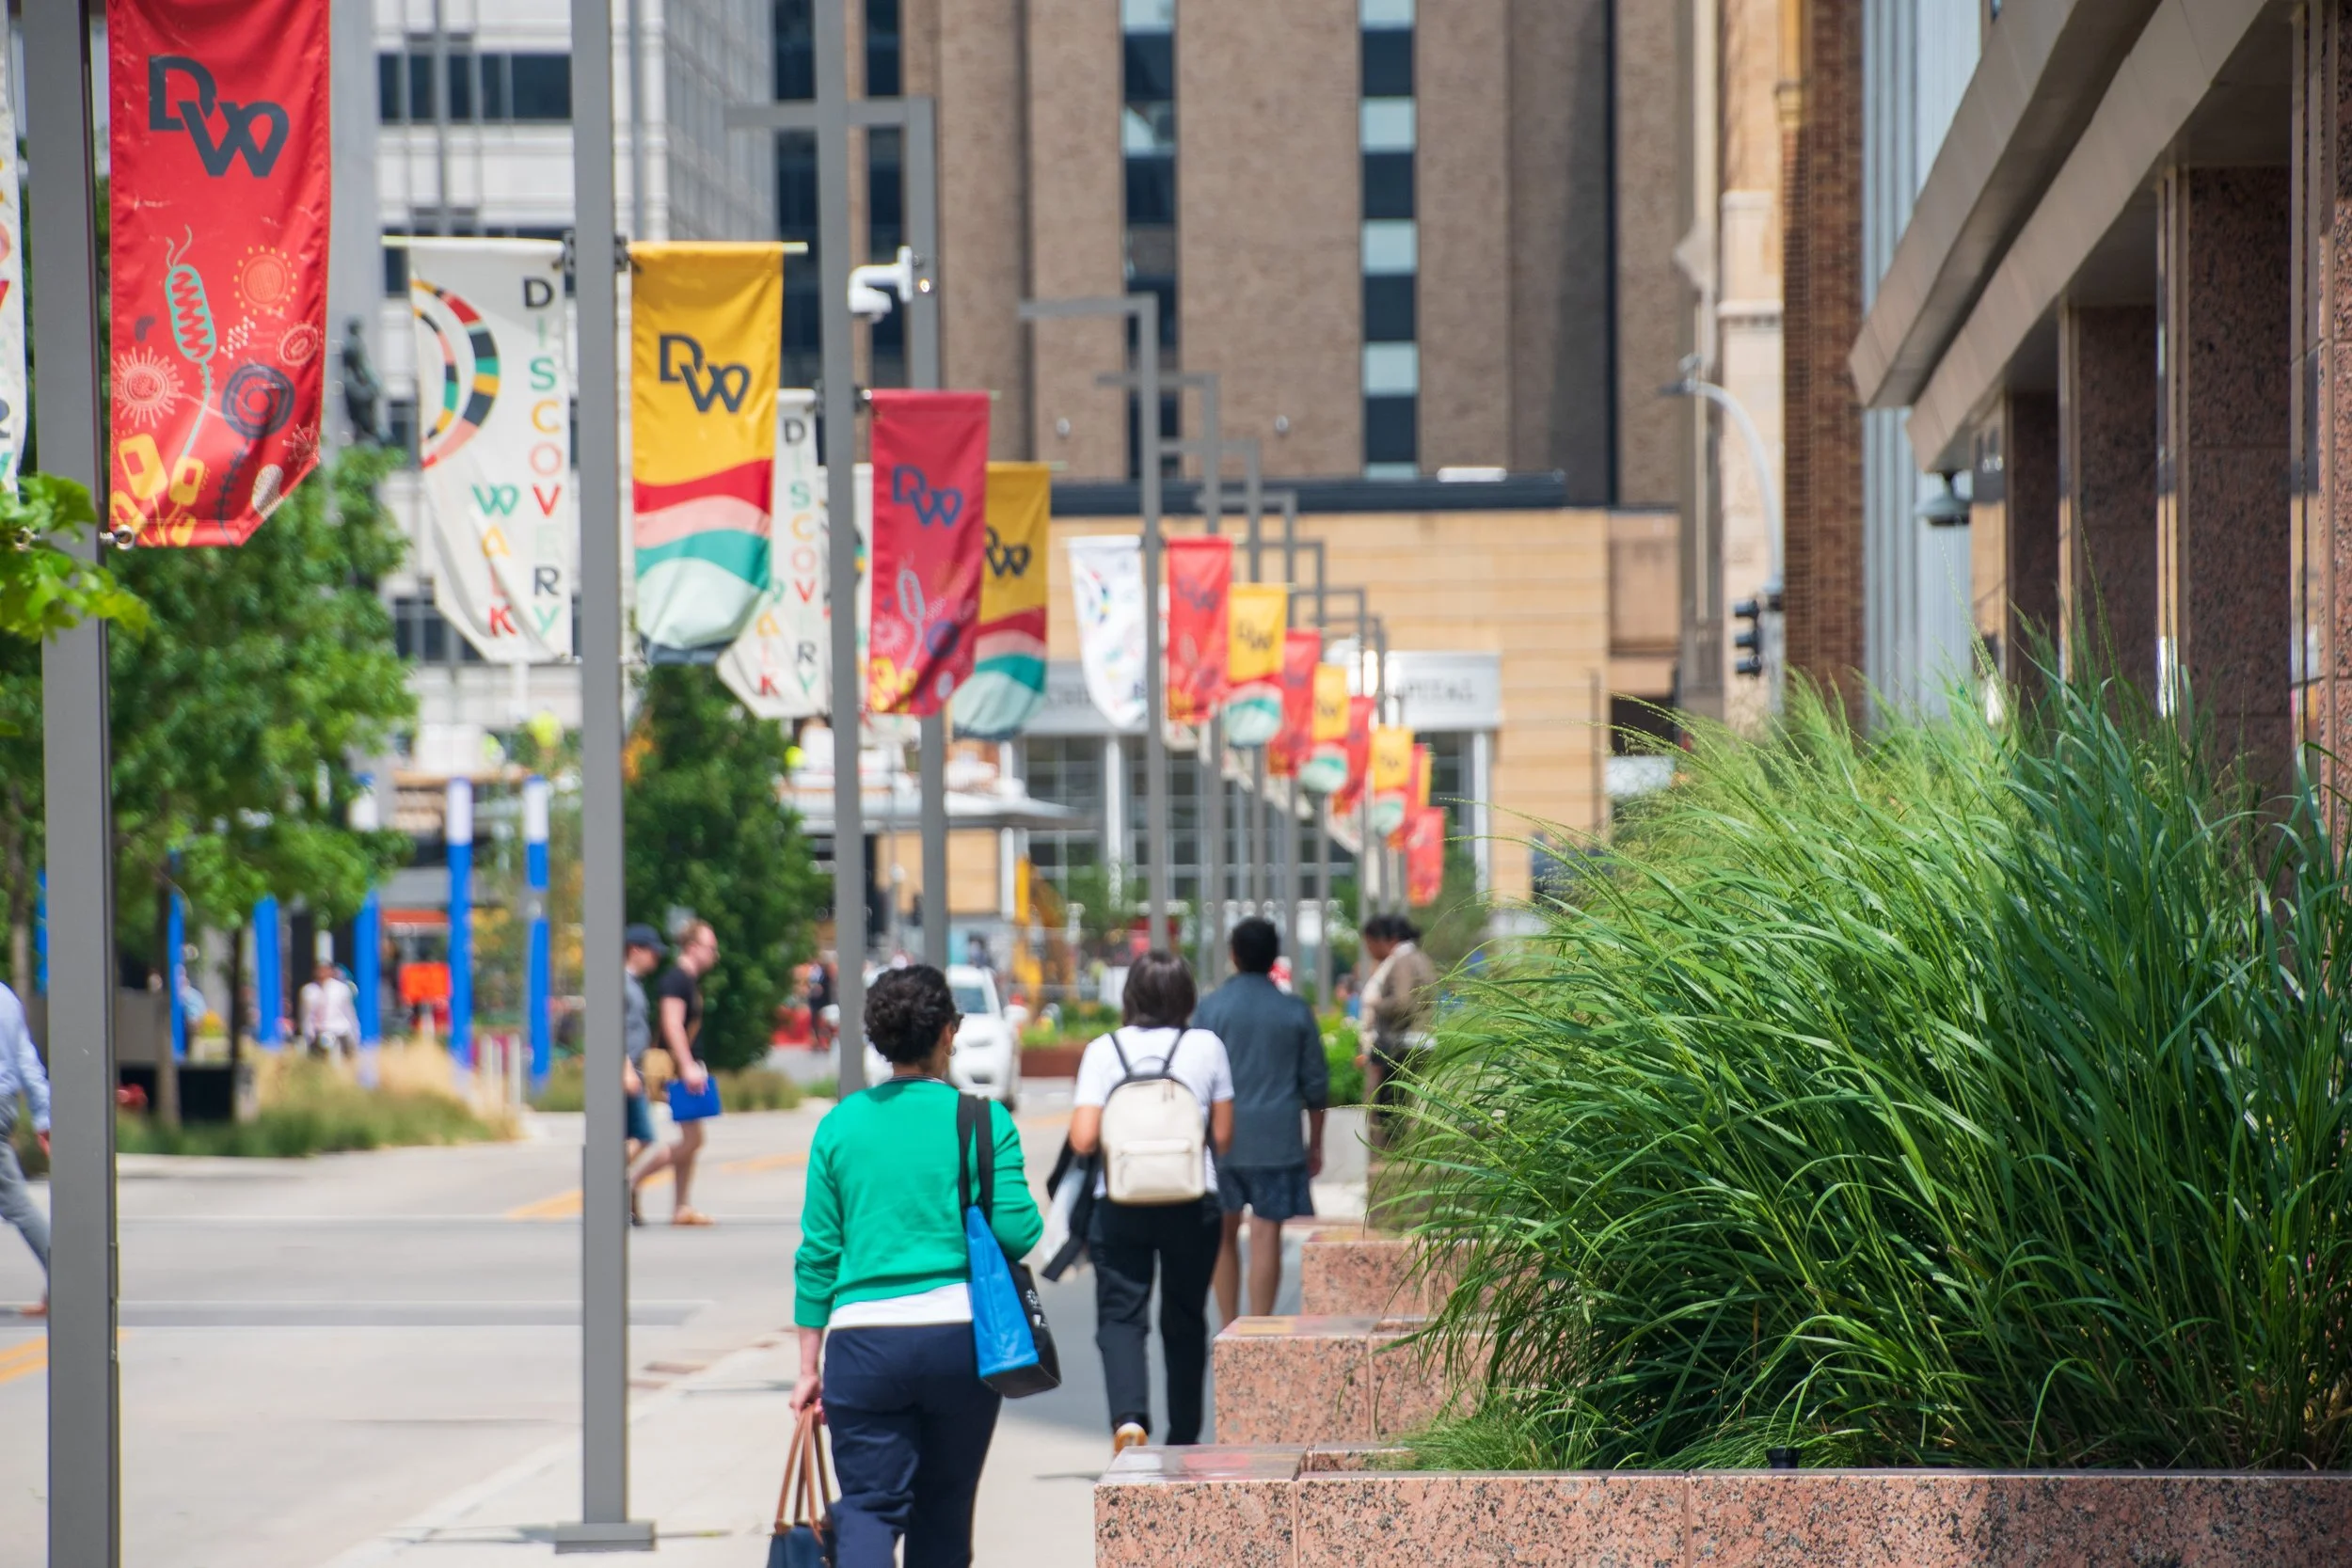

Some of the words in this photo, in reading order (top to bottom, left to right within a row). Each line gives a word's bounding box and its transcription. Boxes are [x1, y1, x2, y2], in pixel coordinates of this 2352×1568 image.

[148, 55, 290, 179] DW
[659, 333, 753, 415] DW
[522, 277, 564, 639] DISCOVERY
[892, 465, 964, 529] DW
[783, 418, 818, 695] DISCOVRY
